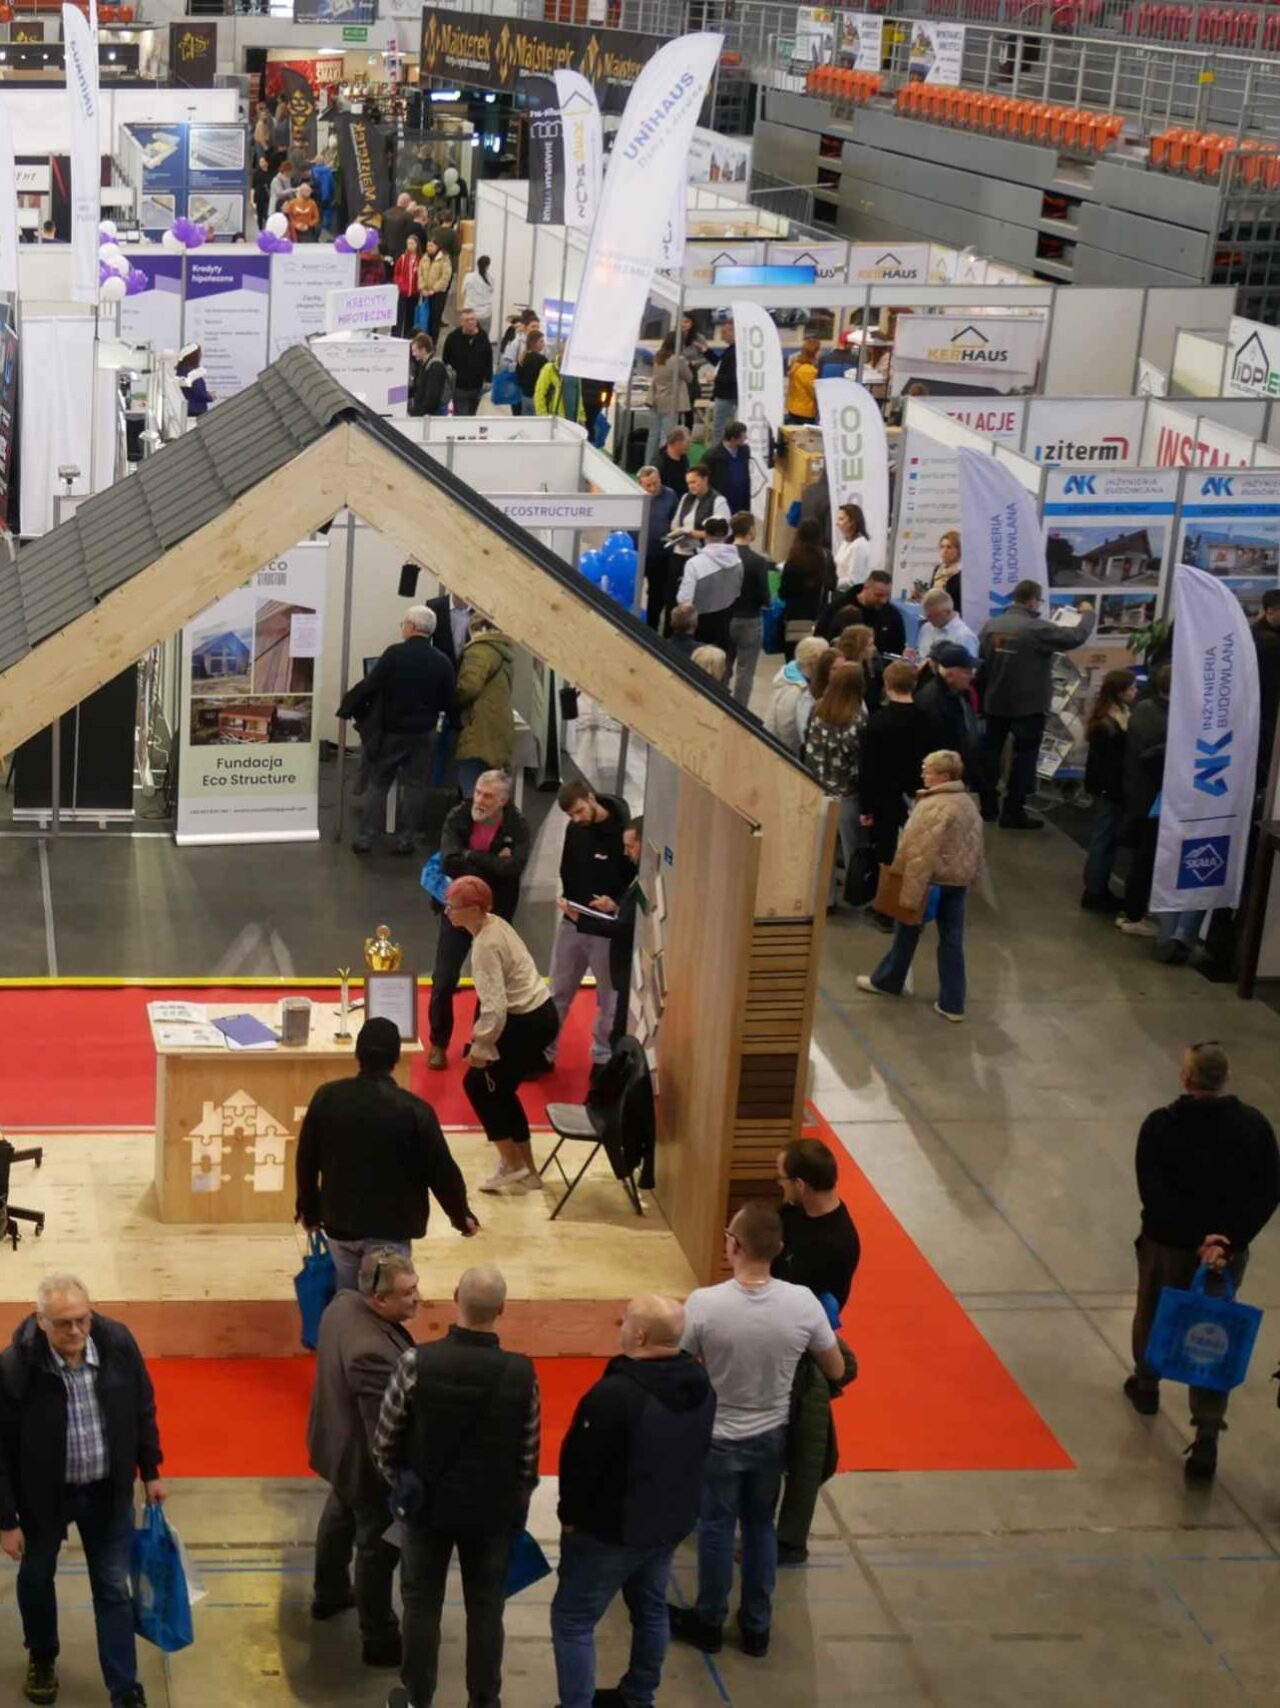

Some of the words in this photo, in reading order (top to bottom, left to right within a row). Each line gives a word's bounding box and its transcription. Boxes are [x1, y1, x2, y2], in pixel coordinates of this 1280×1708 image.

[516, 33, 575, 73] Majsterek
[927, 349, 1009, 363] KERHAUS
[502, 506, 594, 518] ECOSTRUCTURE
[1217, 632, 1236, 729] BUDOWLANA
[216, 755, 284, 771] Fundacja
[202, 774, 227, 787] Eco
[230, 771, 297, 787] Structure
